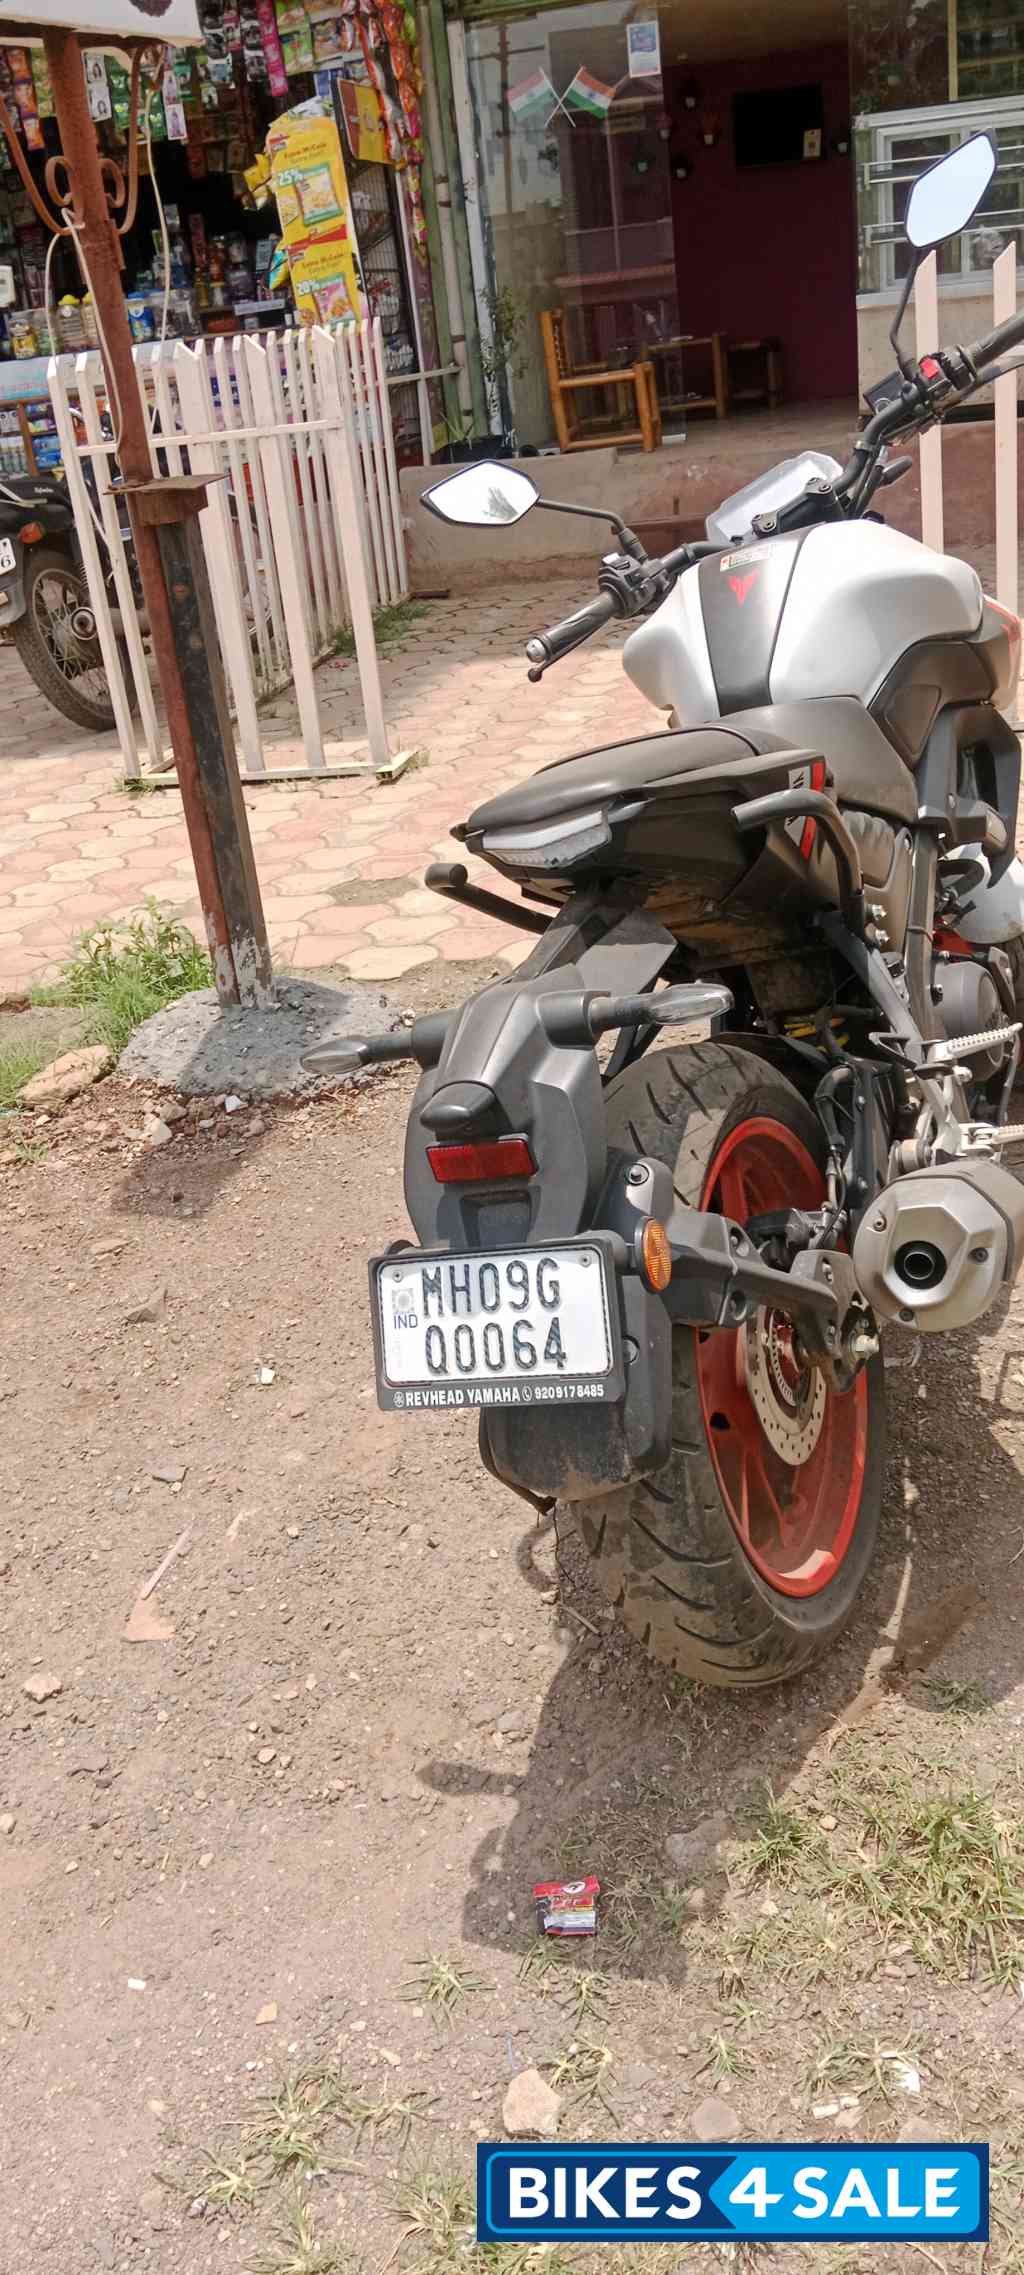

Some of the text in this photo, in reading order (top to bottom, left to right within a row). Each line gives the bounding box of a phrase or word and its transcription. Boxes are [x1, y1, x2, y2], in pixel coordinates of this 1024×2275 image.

[421, 1257, 561, 1317] MH09G
[393, 1313, 419, 1329] IND
[425, 1316, 567, 1375] Q0064
[406, 1383, 605, 1407] REVHEAD YAMAHA 9209178485
